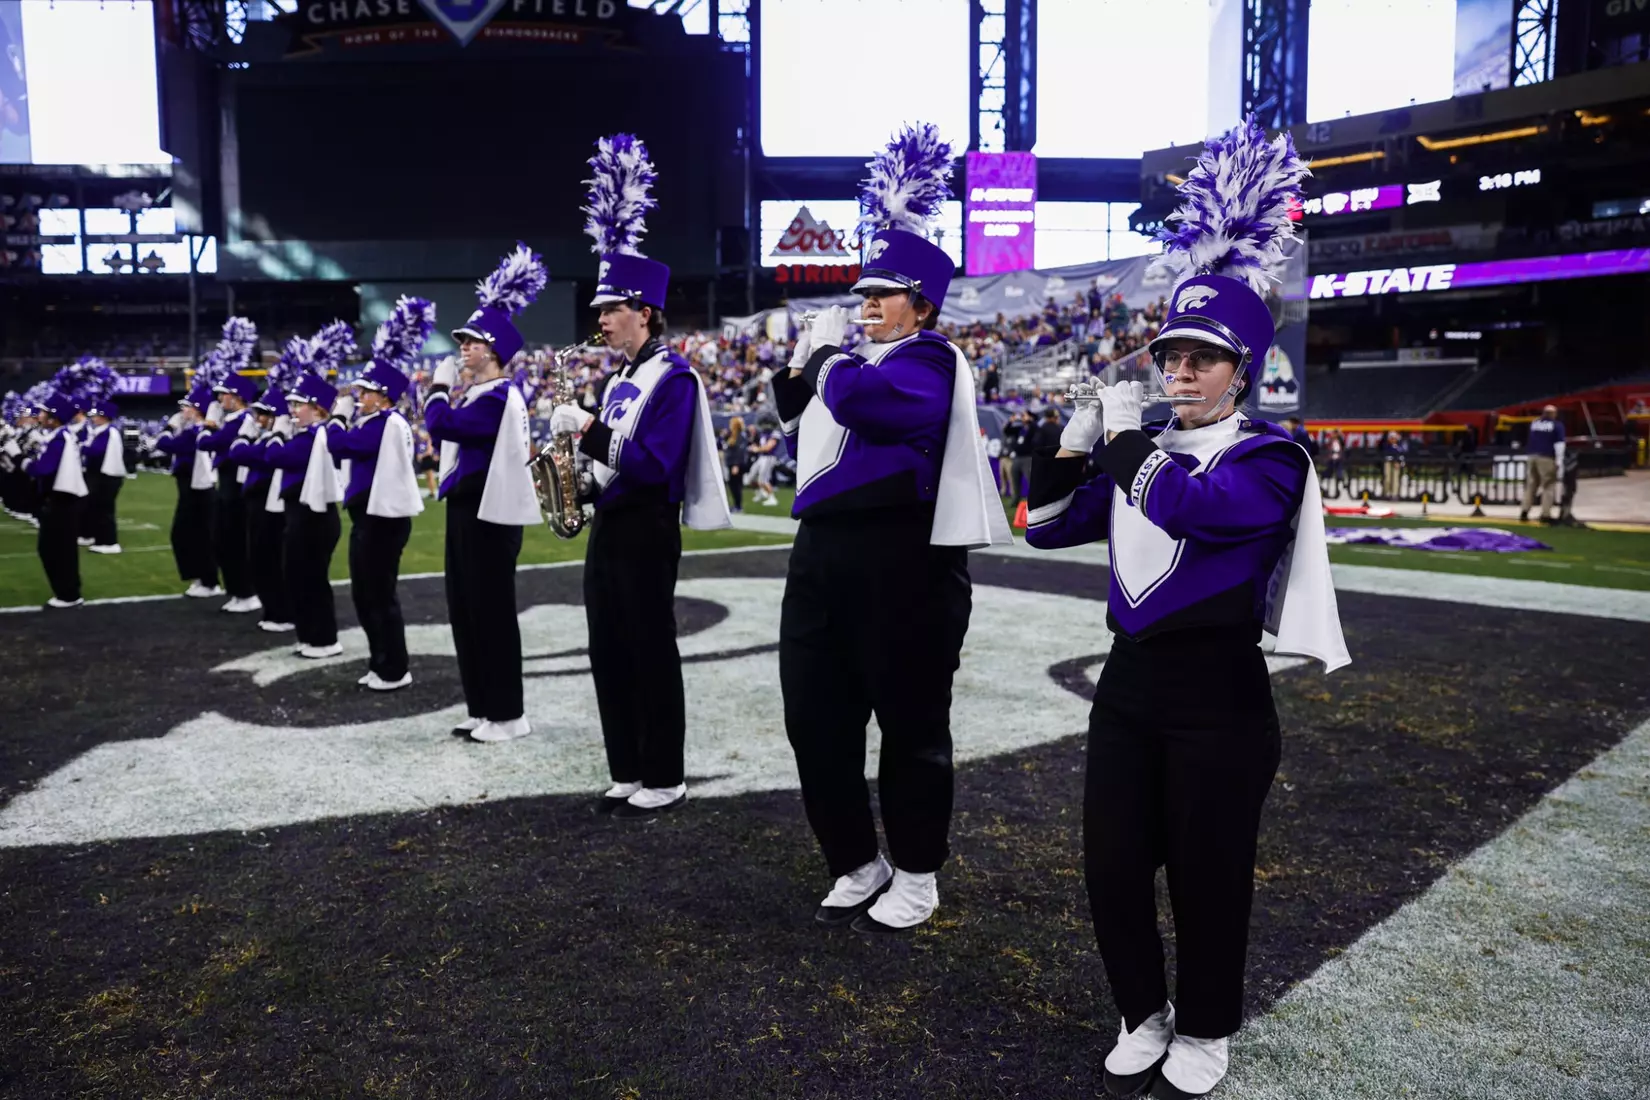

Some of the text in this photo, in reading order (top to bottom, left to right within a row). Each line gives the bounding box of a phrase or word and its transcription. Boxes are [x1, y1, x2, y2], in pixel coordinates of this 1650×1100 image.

[306, 0, 616, 24] CHASE FIELD
[388, 31, 406, 41] OF
[414, 28, 438, 39] THE
[777, 217, 862, 252] Coors
[1309, 264, 1457, 299] K-STATE
[1132, 453, 1163, 506] K-STATE
